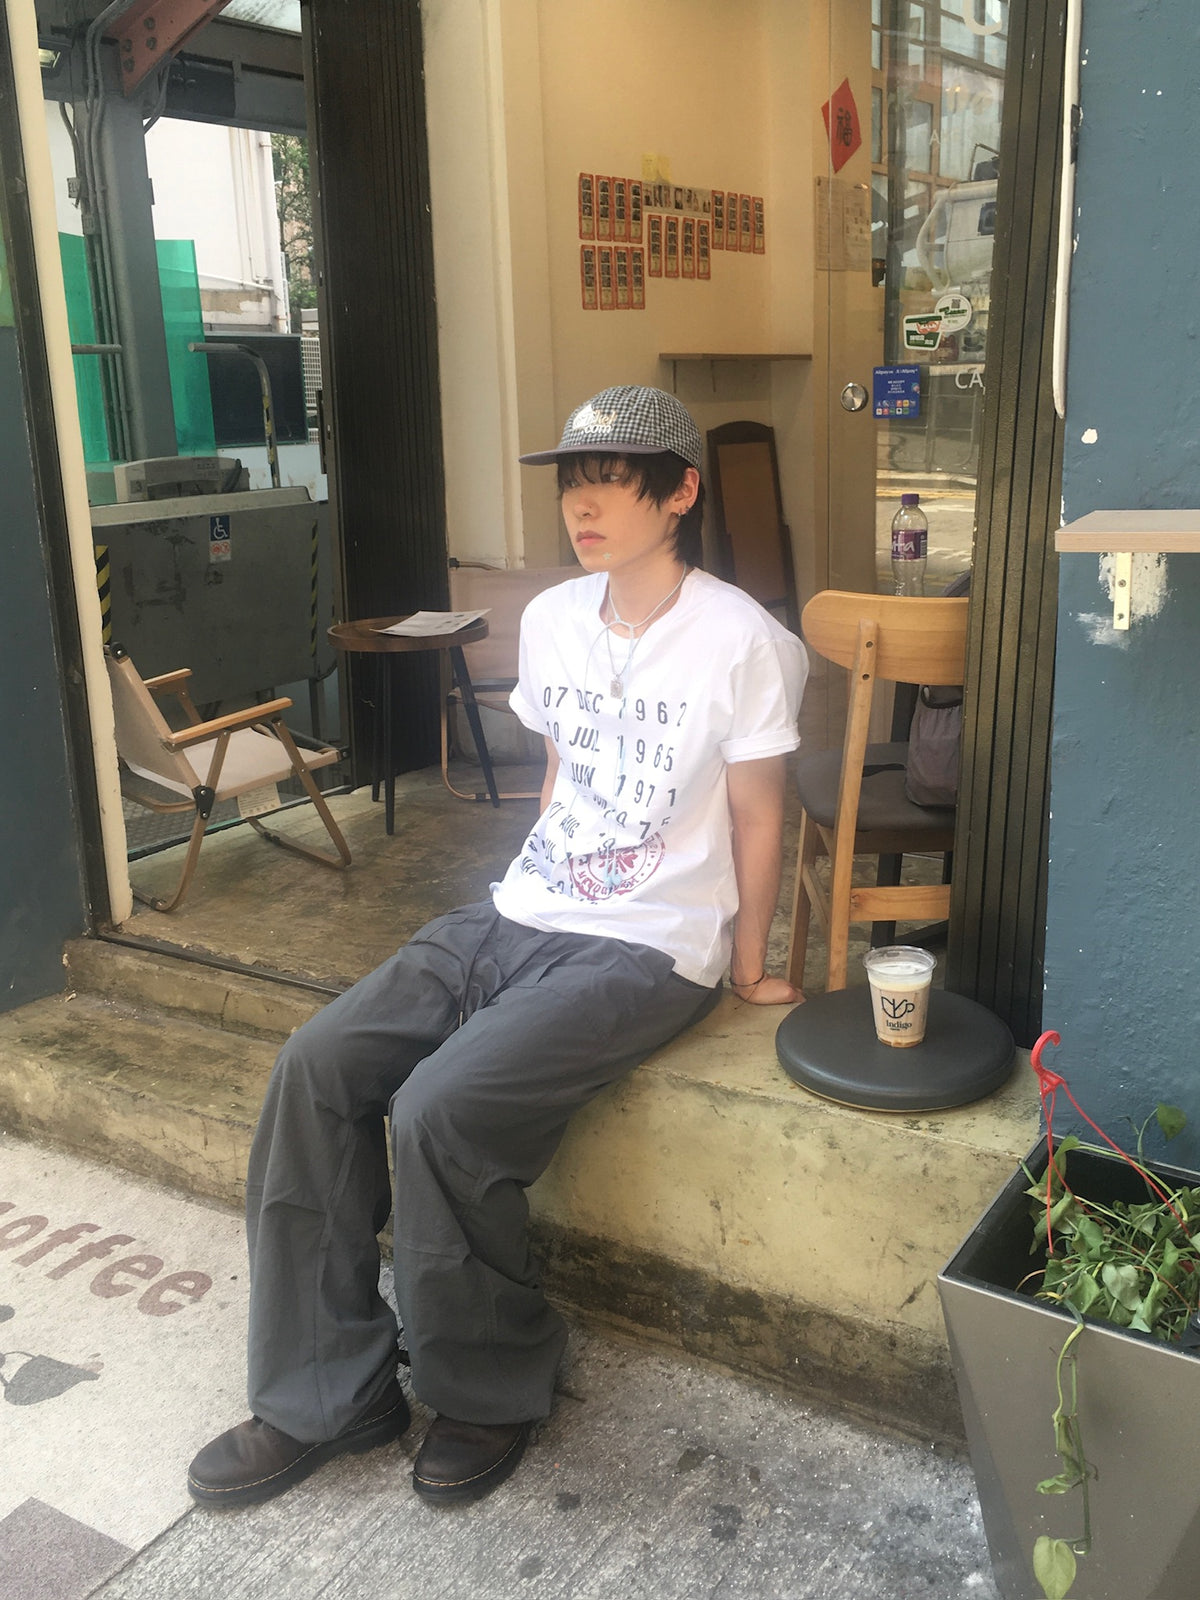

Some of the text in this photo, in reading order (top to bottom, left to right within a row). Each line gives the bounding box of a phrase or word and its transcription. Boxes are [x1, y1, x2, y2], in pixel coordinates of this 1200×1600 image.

[892, 534, 915, 552] ita
[543, 686, 568, 708] 07
[576, 689, 604, 714] DEC
[569, 726, 600, 752] JUL
[617, 735, 674, 772] 1965
[571, 762, 596, 788] JUN
[886, 1019, 912, 1030] Indigo
[0, 1202, 212, 1317] offee
